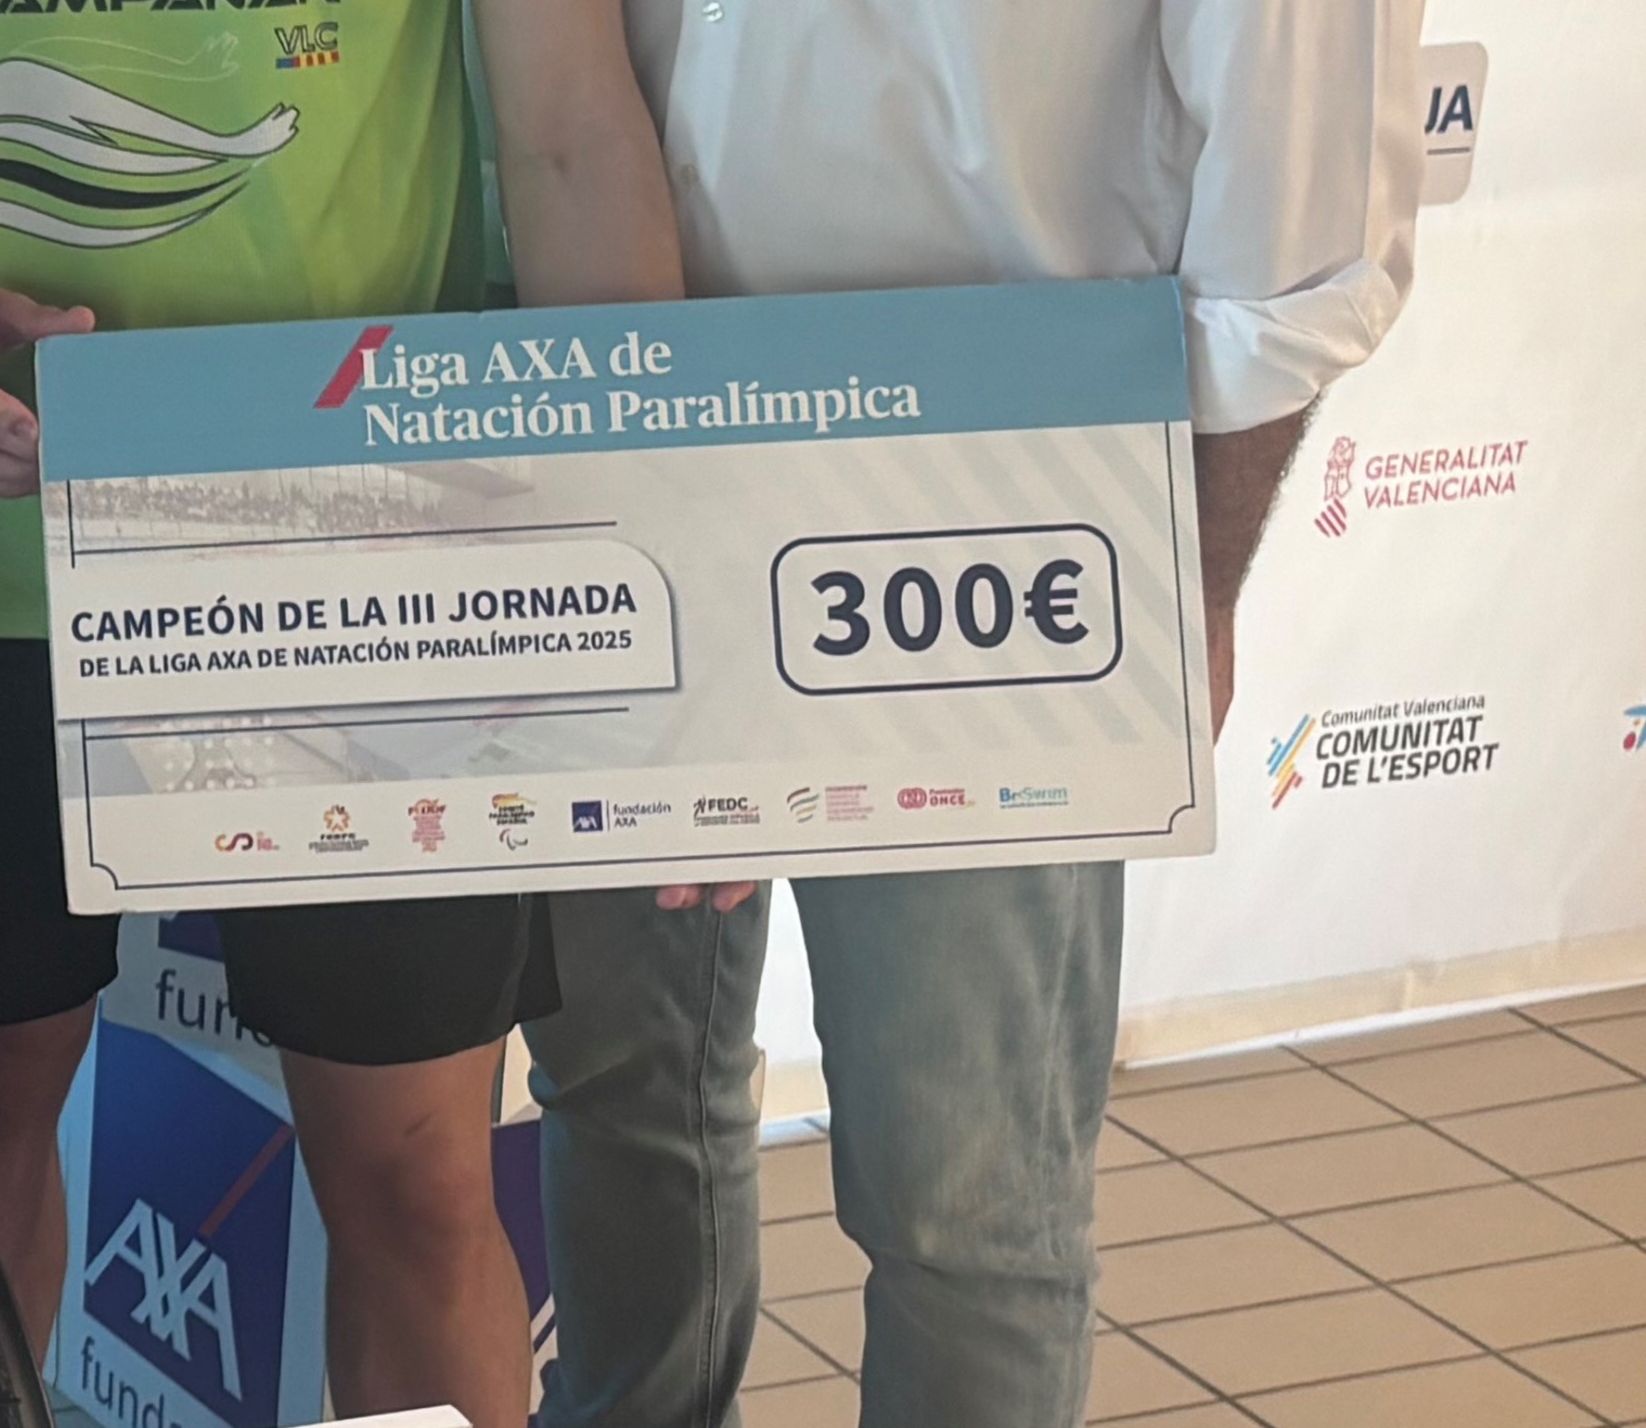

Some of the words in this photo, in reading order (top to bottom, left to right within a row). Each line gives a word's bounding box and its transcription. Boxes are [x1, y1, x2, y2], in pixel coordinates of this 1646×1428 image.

[273, 20, 339, 55] VLC
[359, 345, 469, 400] Liga
[482, 336, 598, 384] AXA
[608, 330, 673, 375] de
[364, 390, 594, 447] Natación
[607, 376, 922, 434] Paralímpica
[1364, 439, 1529, 480] GENERALITAT
[1363, 471, 1517, 510] VALENCIANA
[70, 594, 265, 643] CAMPEÓN
[277, 599, 328, 631] DE
[339, 595, 387, 628] LA
[398, 592, 437, 625] III
[447, 581, 638, 622] JORNADA
[809, 558, 1090, 657] 300€
[79, 657, 109, 678] DE
[115, 655, 145, 677] LA
[148, 652, 203, 675] LIGA
[207, 648, 254, 671] AXA
[257, 646, 289, 669] DE
[293, 635, 410, 667] NATACIÓN
[416, 628, 572, 662] PARALÍMPICA
[577, 629, 633, 651] 2025
[1321, 702, 1400, 728] Comunitat
[1403, 694, 1486, 718] Valenciana
[1315, 714, 1484, 761] COMUNITAT
[1321, 757, 1361, 789] DE
[85, 1197, 245, 1404] AXA
